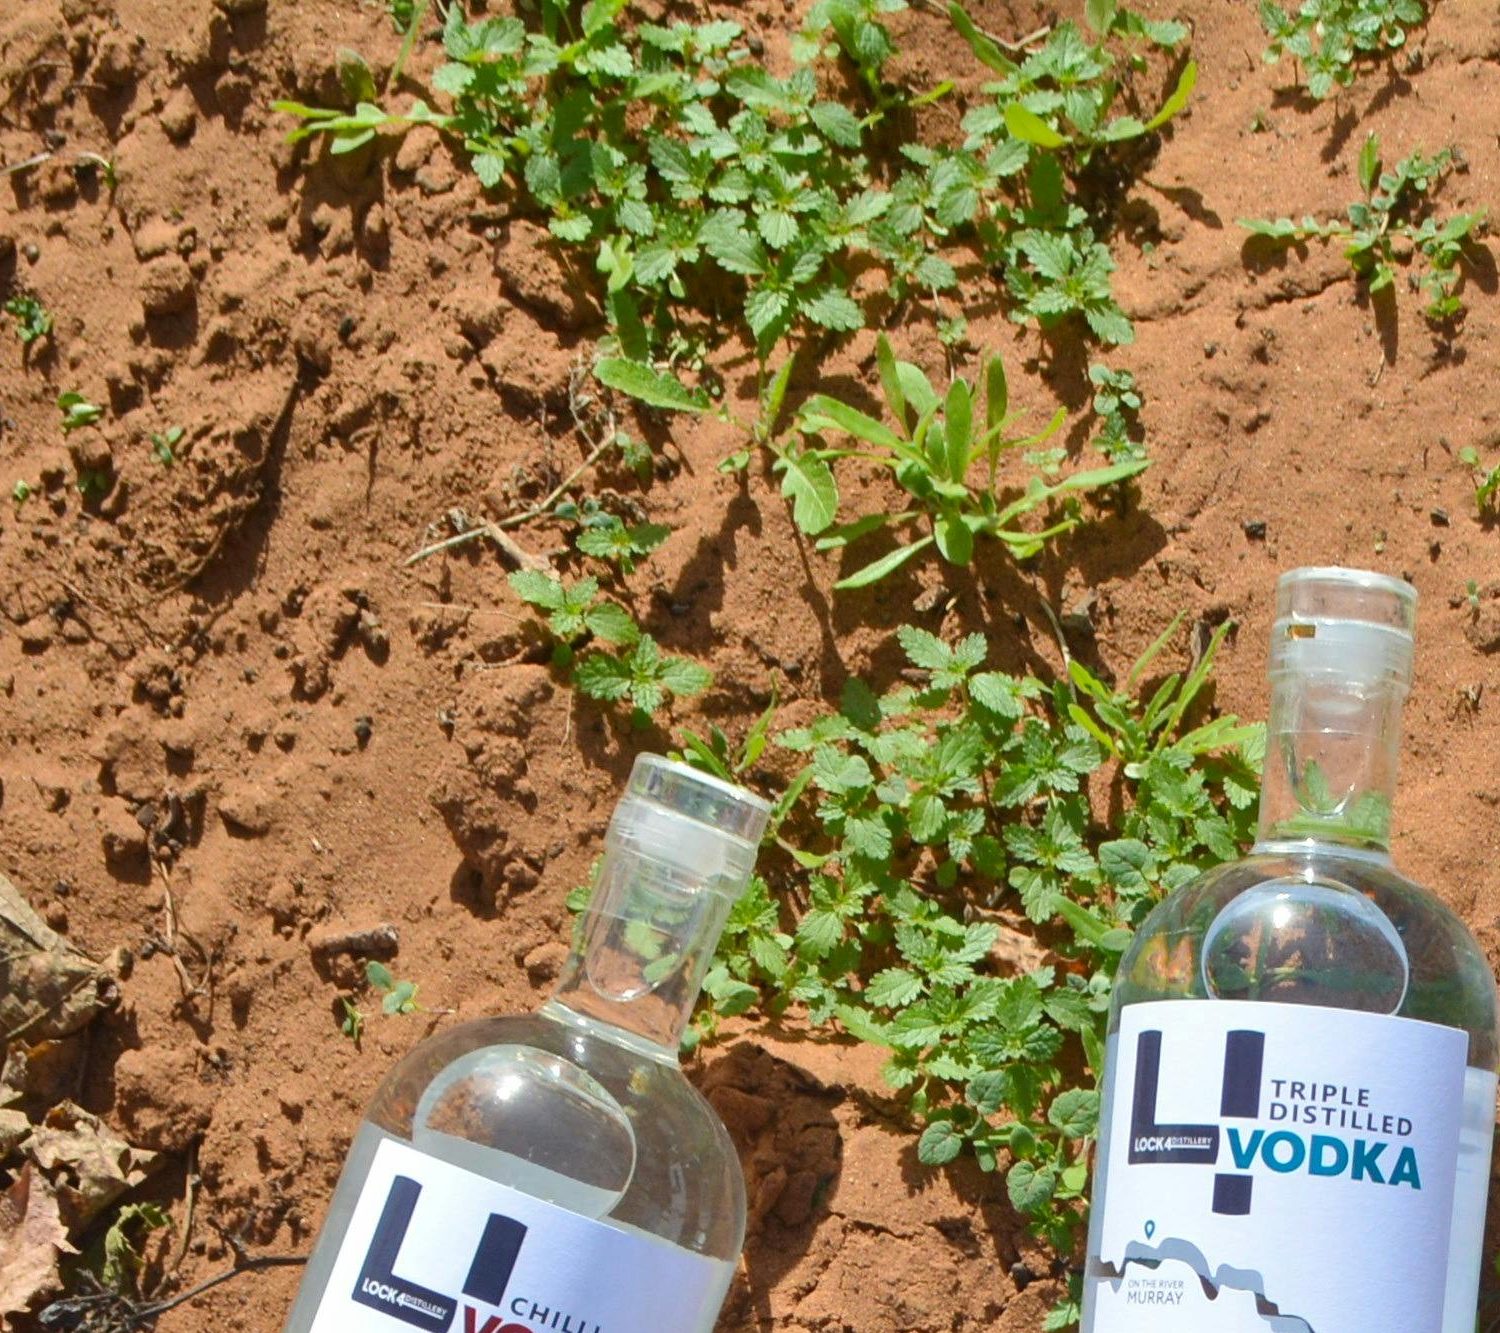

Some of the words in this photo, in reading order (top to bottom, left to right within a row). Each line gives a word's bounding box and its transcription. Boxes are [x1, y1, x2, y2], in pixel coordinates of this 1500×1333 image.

[1270, 1079, 1371, 1107] TRIPLE
[1269, 1102, 1414, 1137] DISTILLED
[1171, 1136, 1213, 1144] DISTILLERY
[1223, 1126, 1425, 1190] VODKA
[1127, 1278, 1141, 1287] ON
[1141, 1278, 1157, 1288] THE
[1158, 1279, 1184, 1289] RIVER
[403, 1293, 447, 1317] DISTILLERY
[1126, 1290, 1182, 1306] MURRAY
